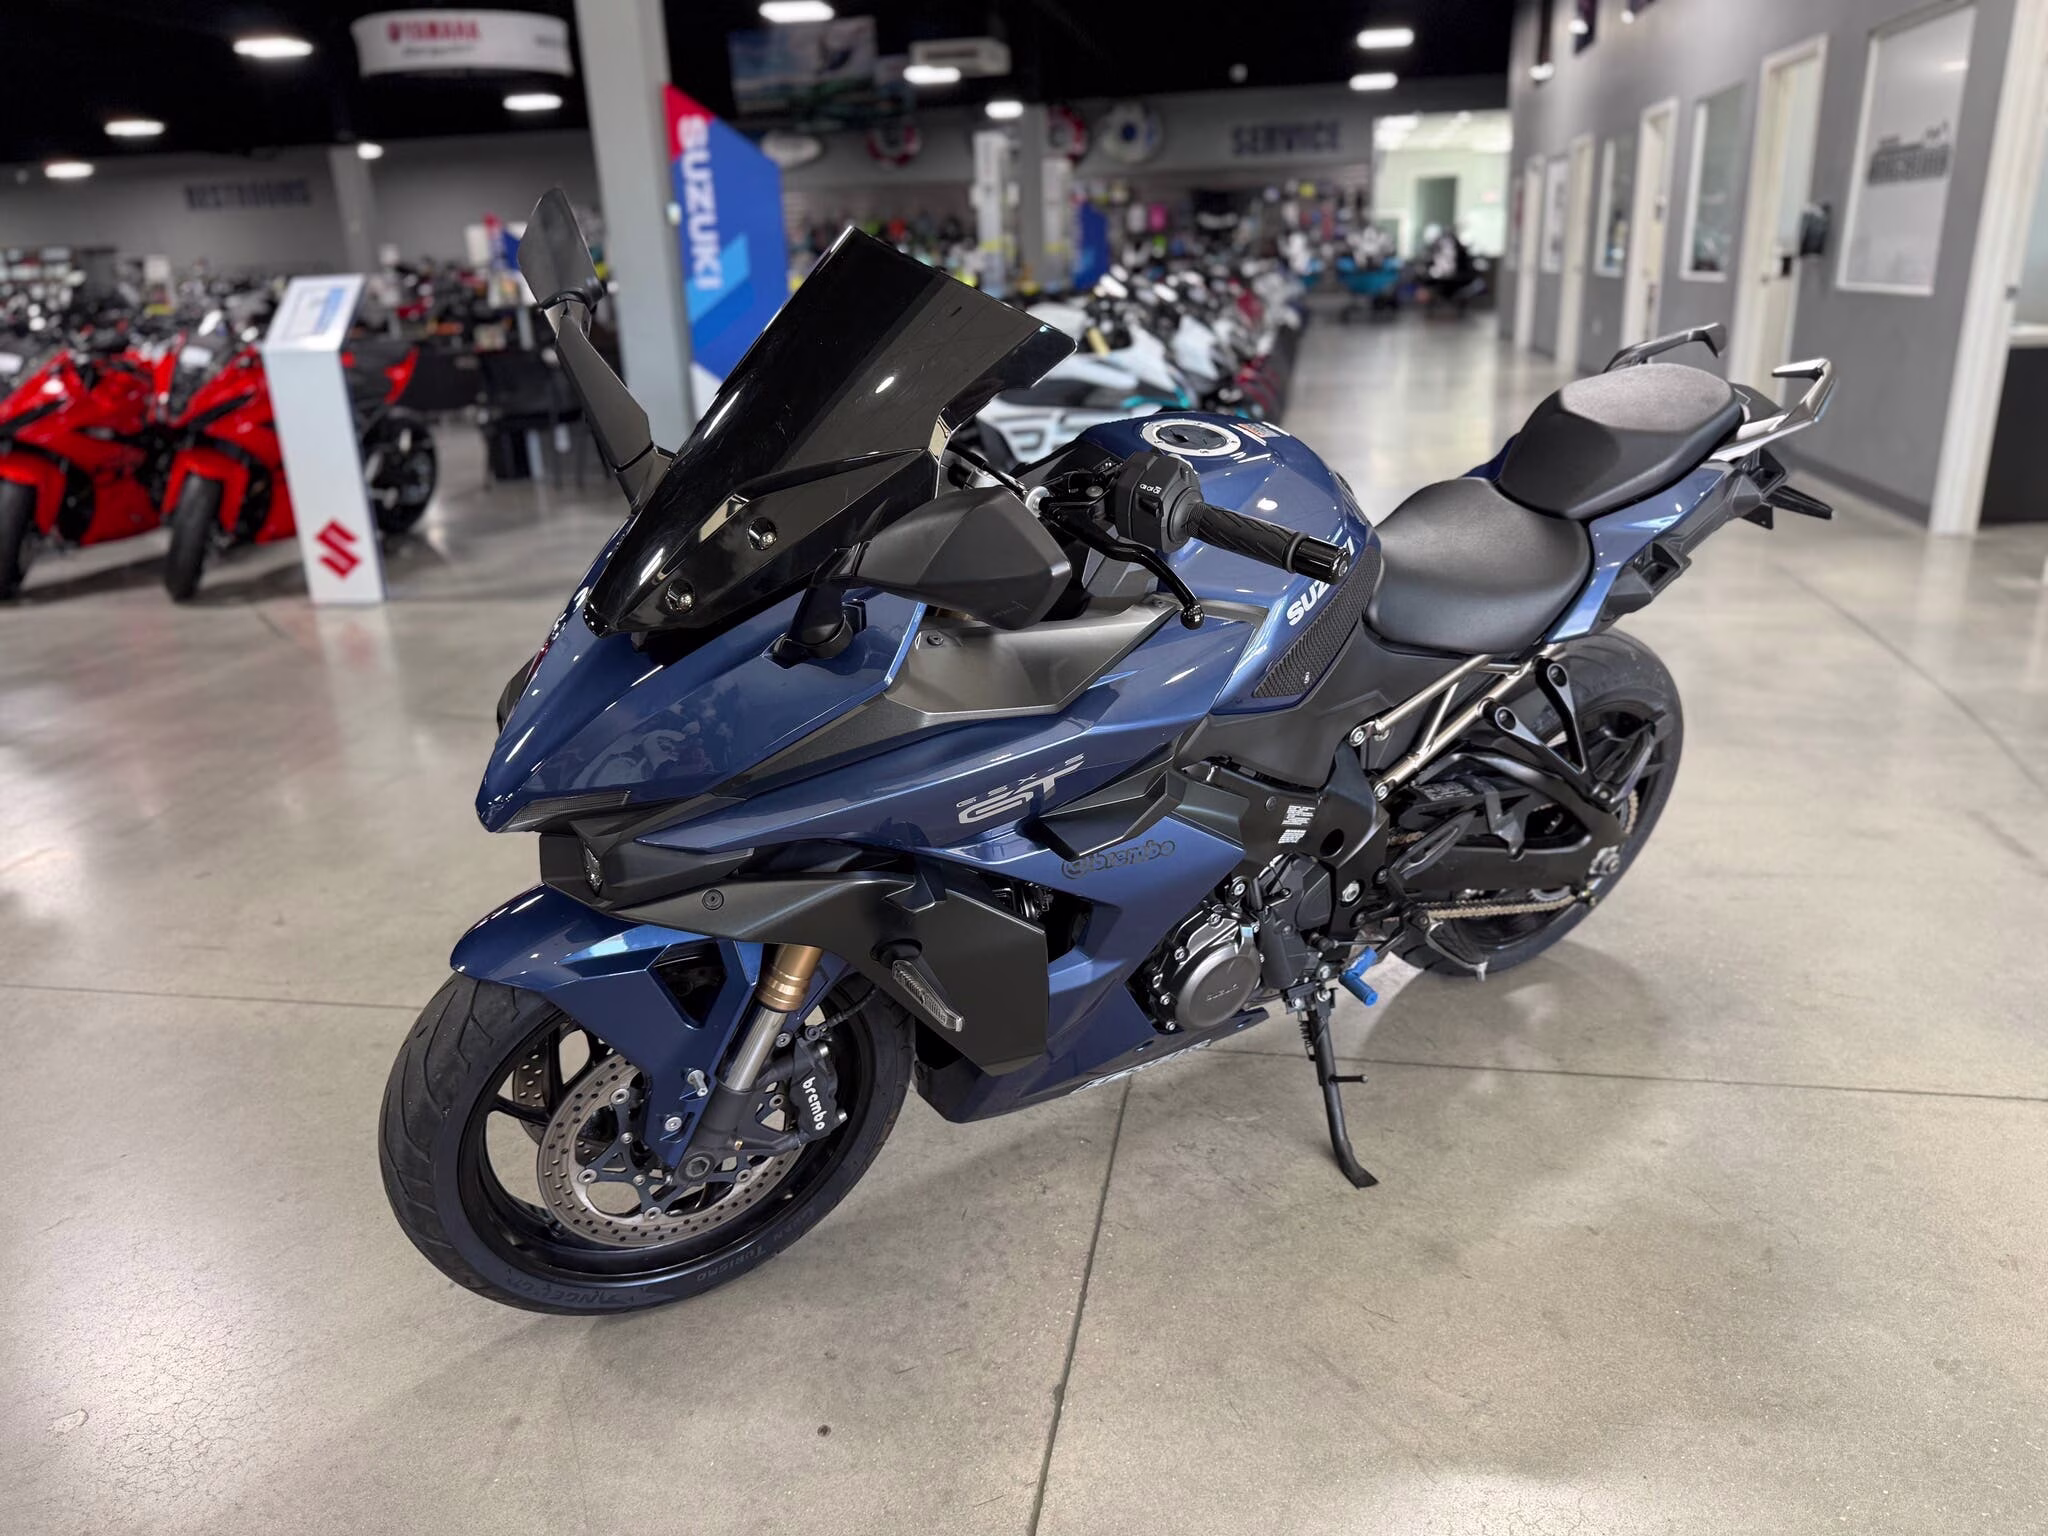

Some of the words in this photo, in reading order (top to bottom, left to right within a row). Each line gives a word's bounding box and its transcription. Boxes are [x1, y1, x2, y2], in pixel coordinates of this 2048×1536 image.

[677, 114, 722, 290] SUZUKI
[958, 760, 1086, 824] GT
[1088, 840, 1176, 872] brembo
[802, 1076, 828, 1131] brembo
